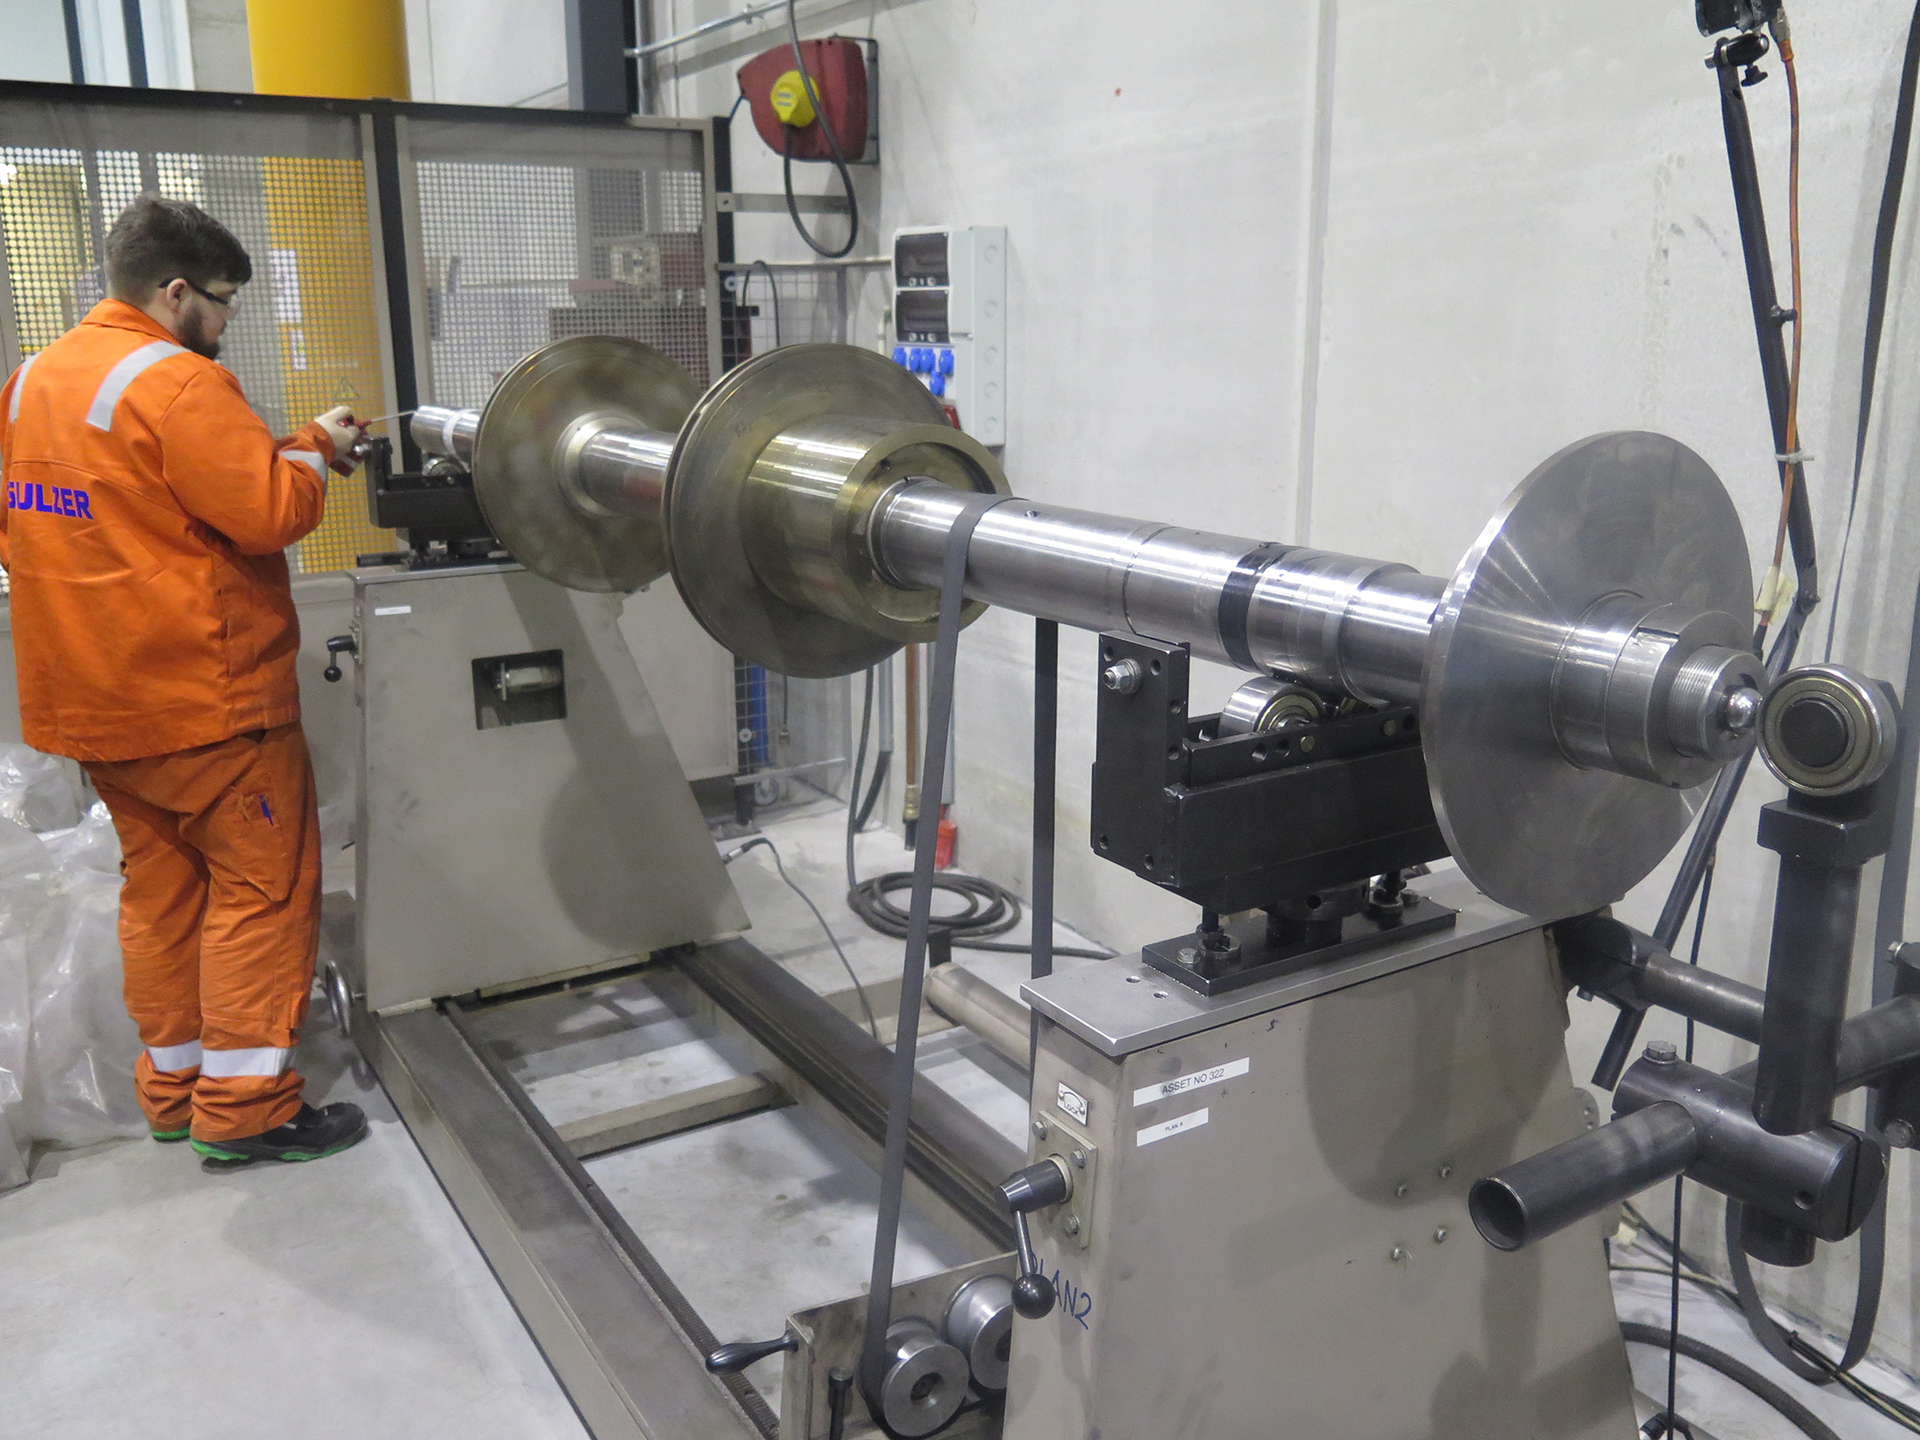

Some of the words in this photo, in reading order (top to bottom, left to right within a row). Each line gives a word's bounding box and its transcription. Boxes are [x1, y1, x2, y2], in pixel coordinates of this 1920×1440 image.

[8, 482, 94, 520] SULZER
[1162, 1078, 1192, 1095] ASSET
[1193, 1073, 1207, 1085] NO
[1209, 1068, 1225, 1081] 322
[1165, 1123, 1178, 1132] PLAN
